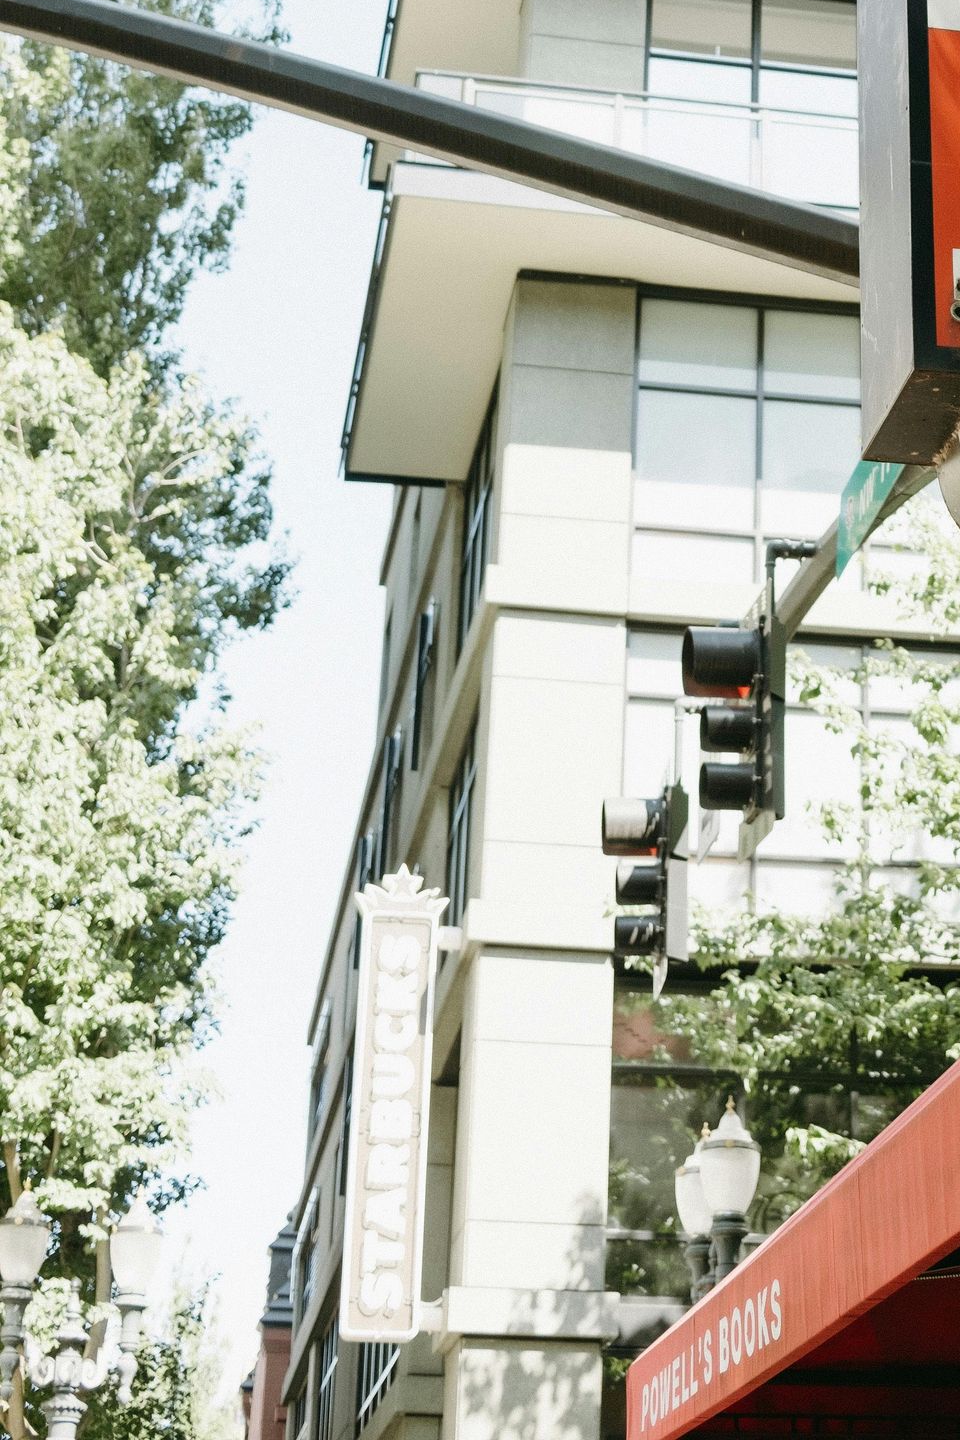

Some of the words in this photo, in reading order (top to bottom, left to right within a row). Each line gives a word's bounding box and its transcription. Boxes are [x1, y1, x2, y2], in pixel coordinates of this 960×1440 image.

[358, 933, 422, 1318] STARBUCKS
[641, 1328, 712, 1432] POWELL'S
[719, 1278, 782, 1374] BOOKS
